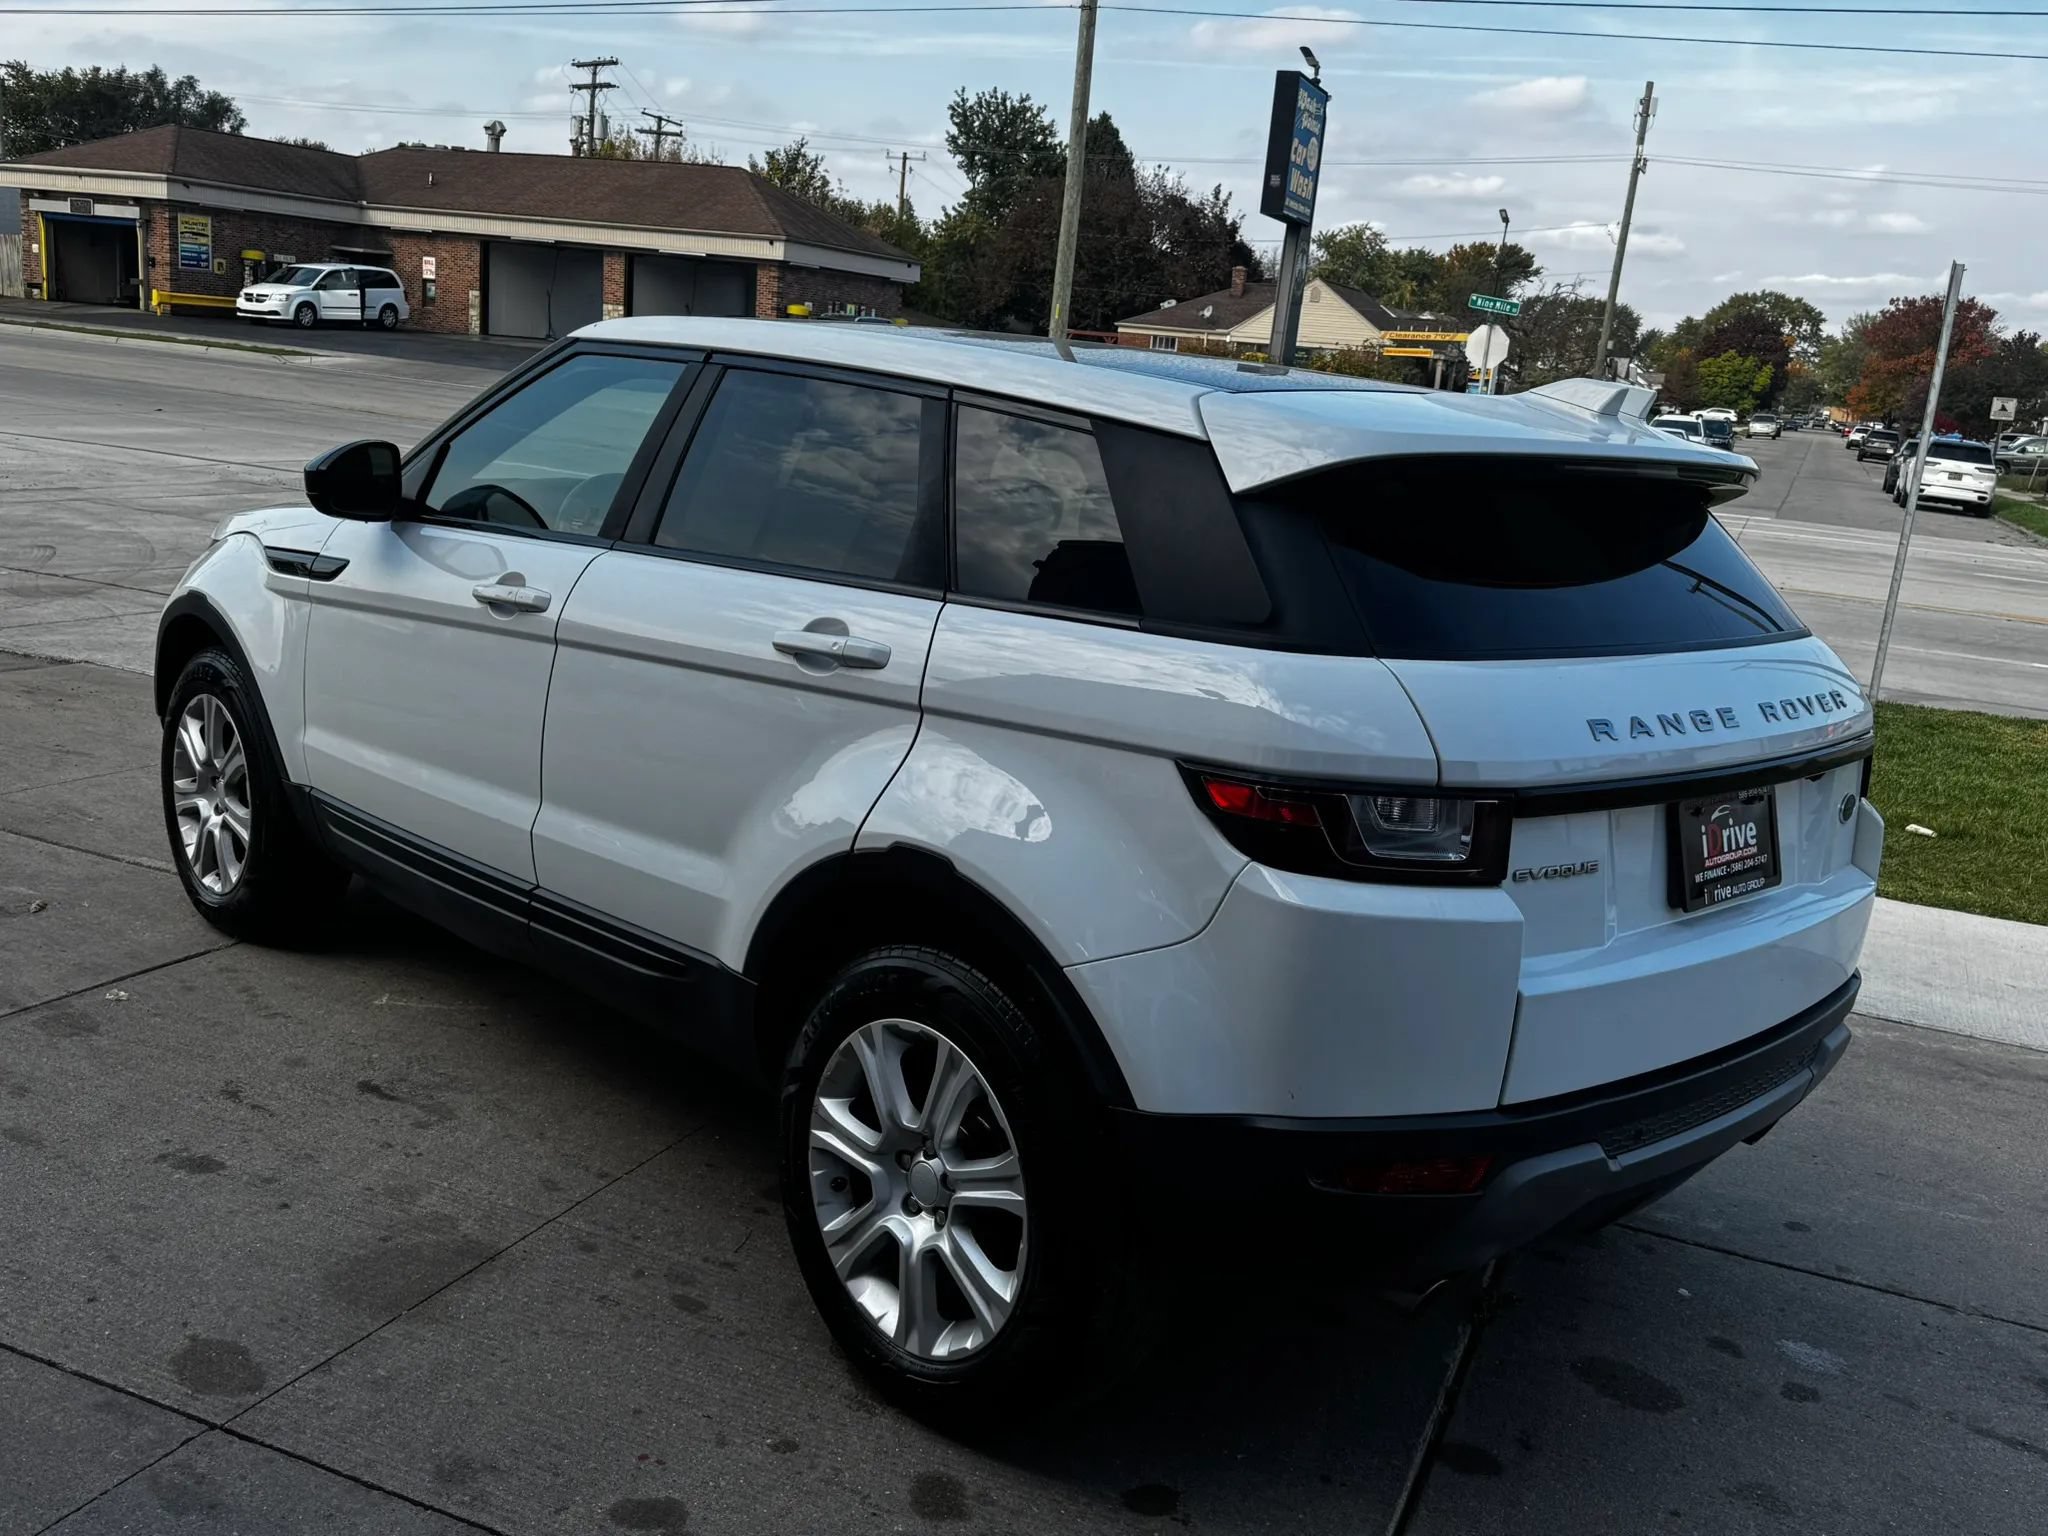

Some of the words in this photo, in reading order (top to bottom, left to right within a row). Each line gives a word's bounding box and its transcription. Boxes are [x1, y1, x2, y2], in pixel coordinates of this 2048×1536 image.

[1291, 138, 1307, 166] Car
[1290, 168, 1313, 200] Wash
[1476, 297, 1494, 308] Nine
[1495, 300, 1512, 312] Mile
[1586, 706, 1739, 741] RANGE
[1758, 690, 1848, 722] ROVER
[1701, 817, 1757, 858] iDrive
[1704, 845, 1758, 867] AUTOGROUP.COM
[1512, 859, 1600, 882] EVOQUE
[1694, 871, 1704, 883] WE
[1704, 865, 1727, 882] FINANCE
[1732, 882, 1747, 894] AUTO
[1746, 877, 1765, 891] GROUP
